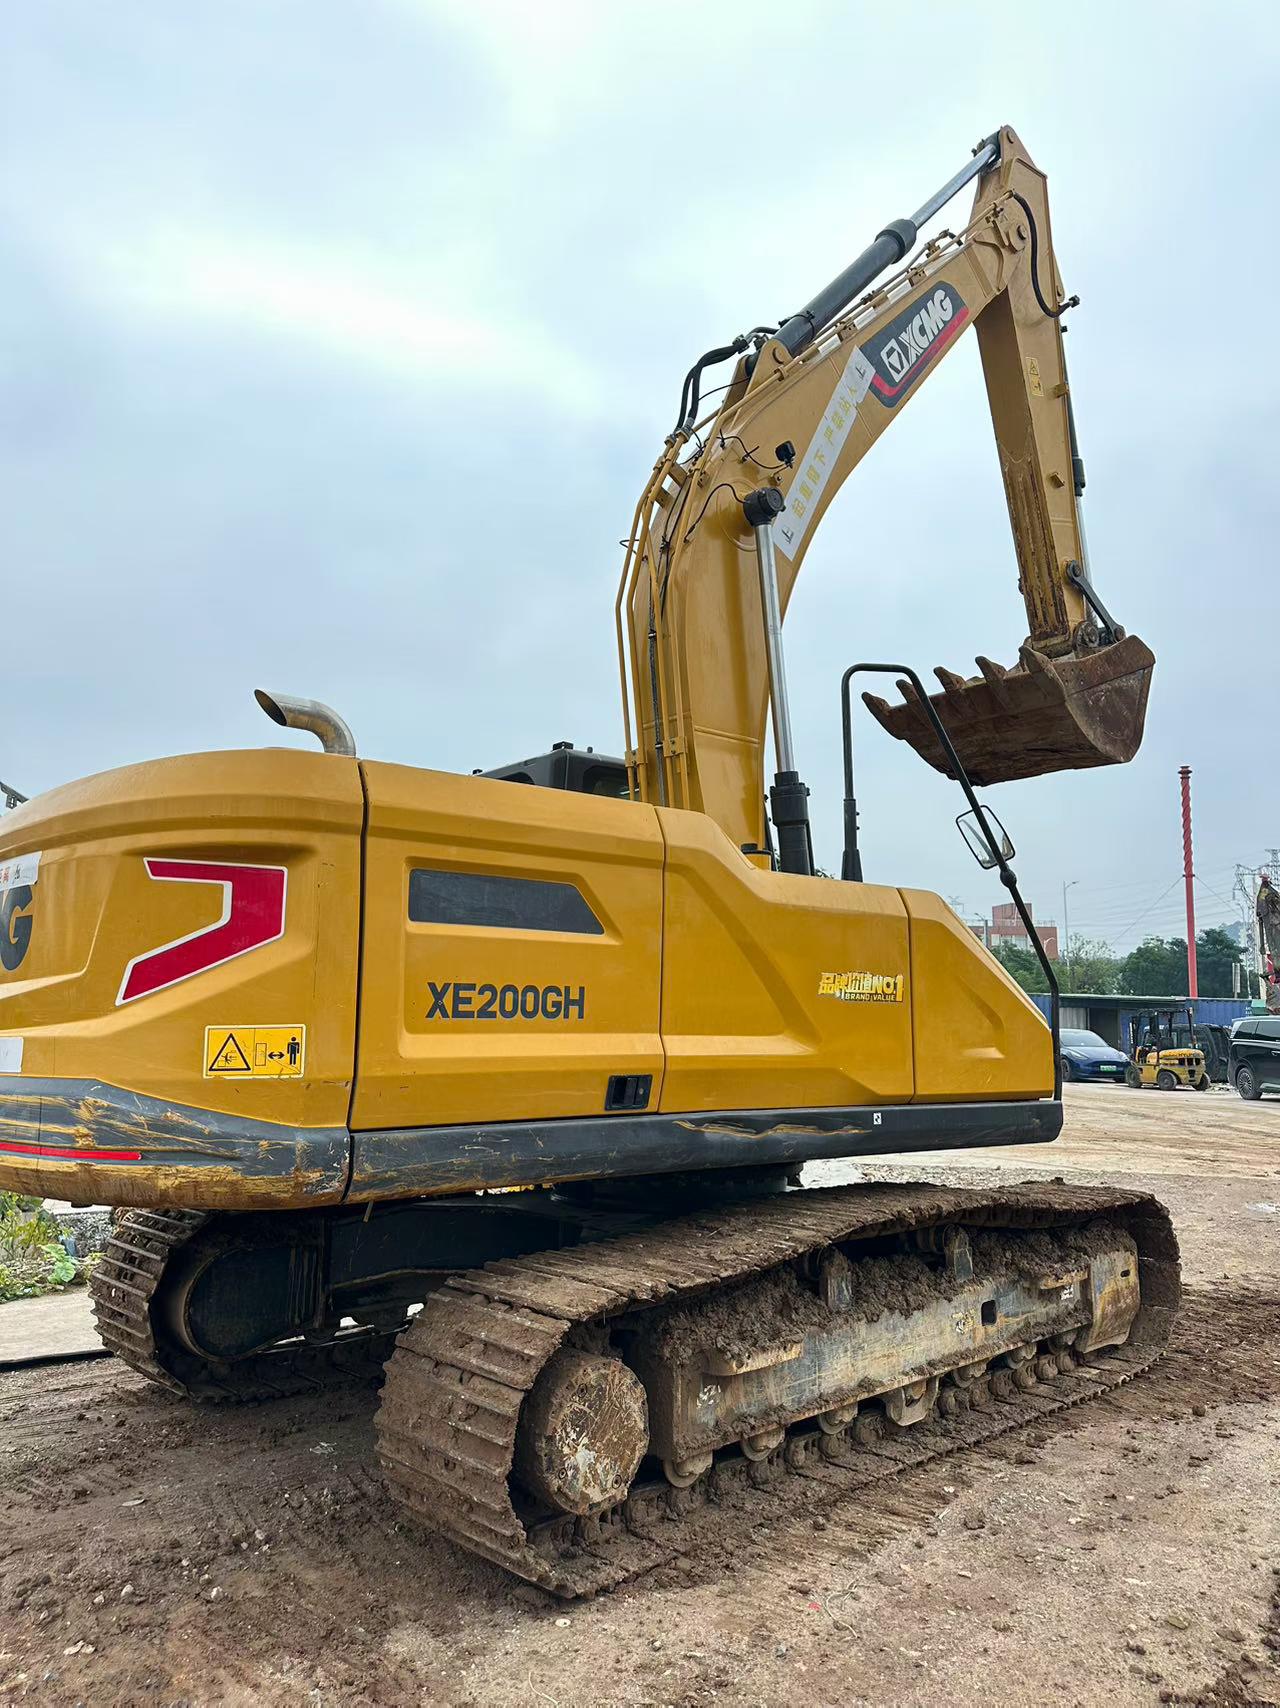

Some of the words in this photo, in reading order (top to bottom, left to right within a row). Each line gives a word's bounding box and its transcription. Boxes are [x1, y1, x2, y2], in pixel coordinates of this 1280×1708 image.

[899, 289, 954, 367] XCMG
[0, 884, 33, 970] G
[425, 981, 585, 1020] XE200GH
[845, 993, 870, 1001] BRAND
[873, 993, 896, 1001] VALUE
